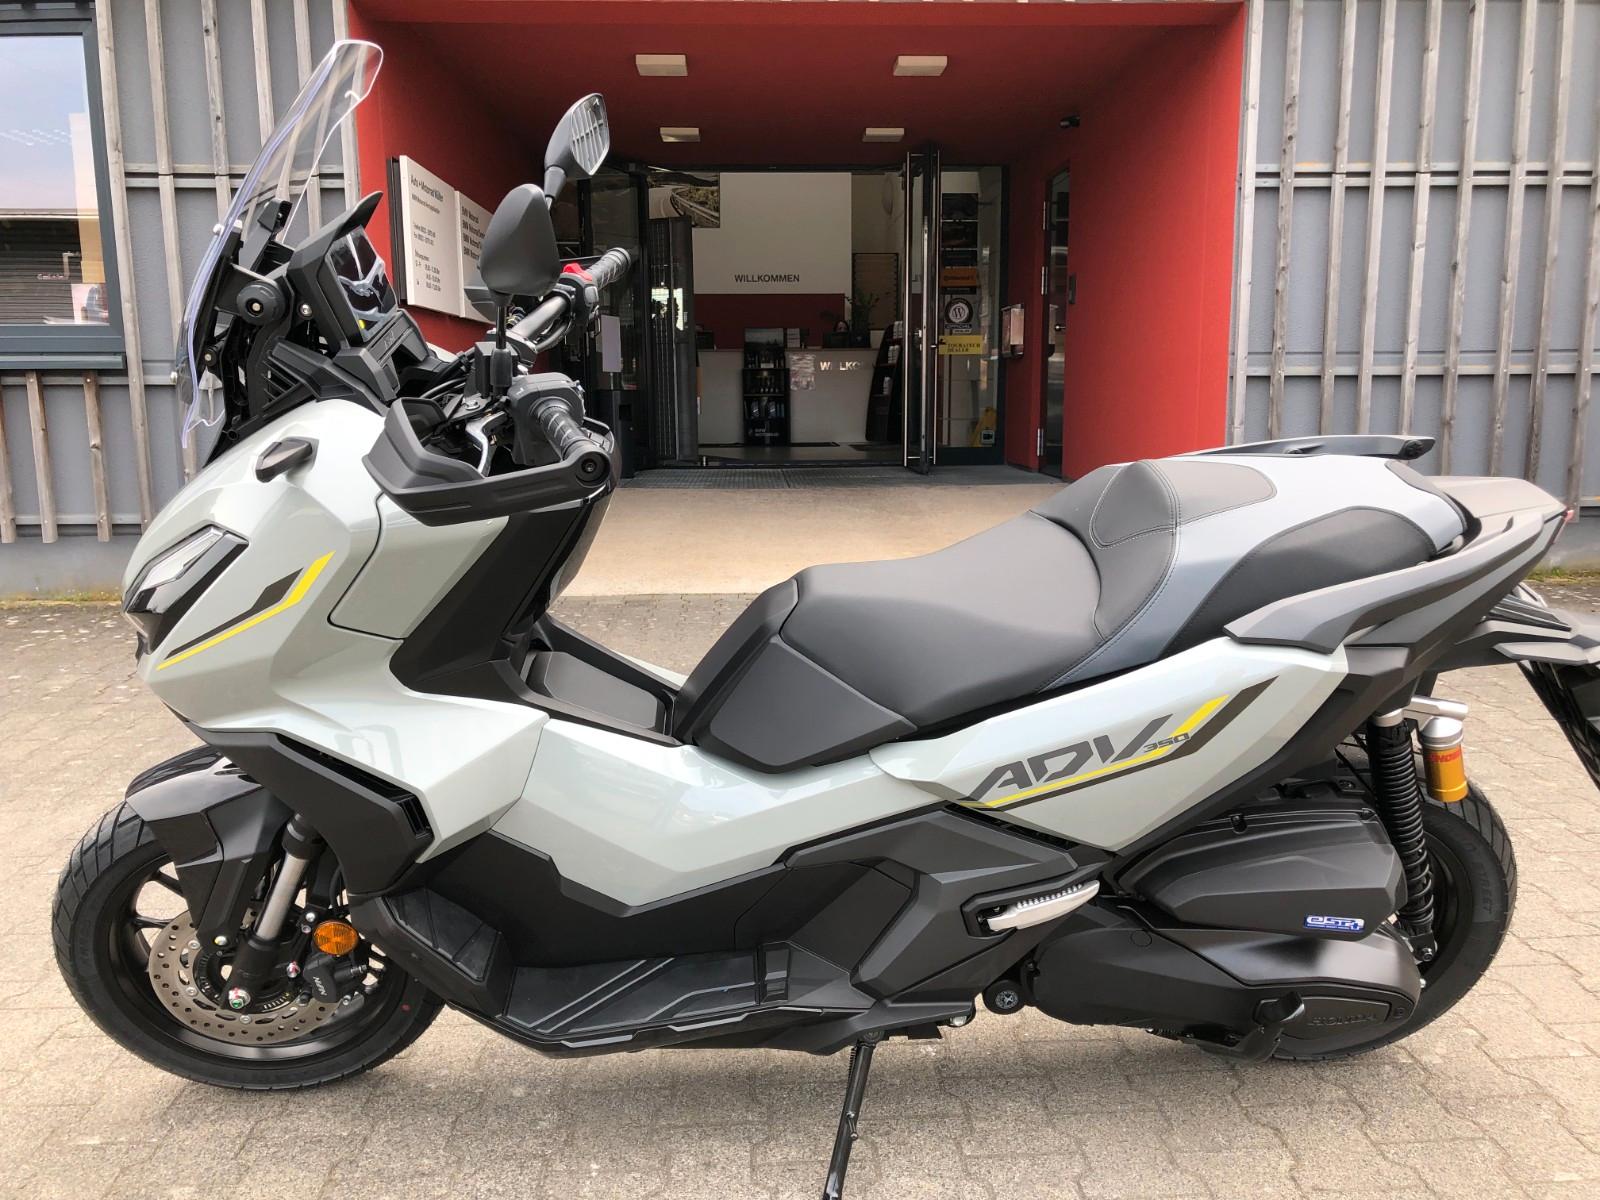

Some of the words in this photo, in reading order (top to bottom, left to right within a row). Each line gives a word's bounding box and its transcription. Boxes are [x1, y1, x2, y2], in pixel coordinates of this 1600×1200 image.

[734, 274, 800, 283] WILLKOMMEN
[974, 713, 1173, 801] ADV
[1143, 731, 1191, 754] 350
